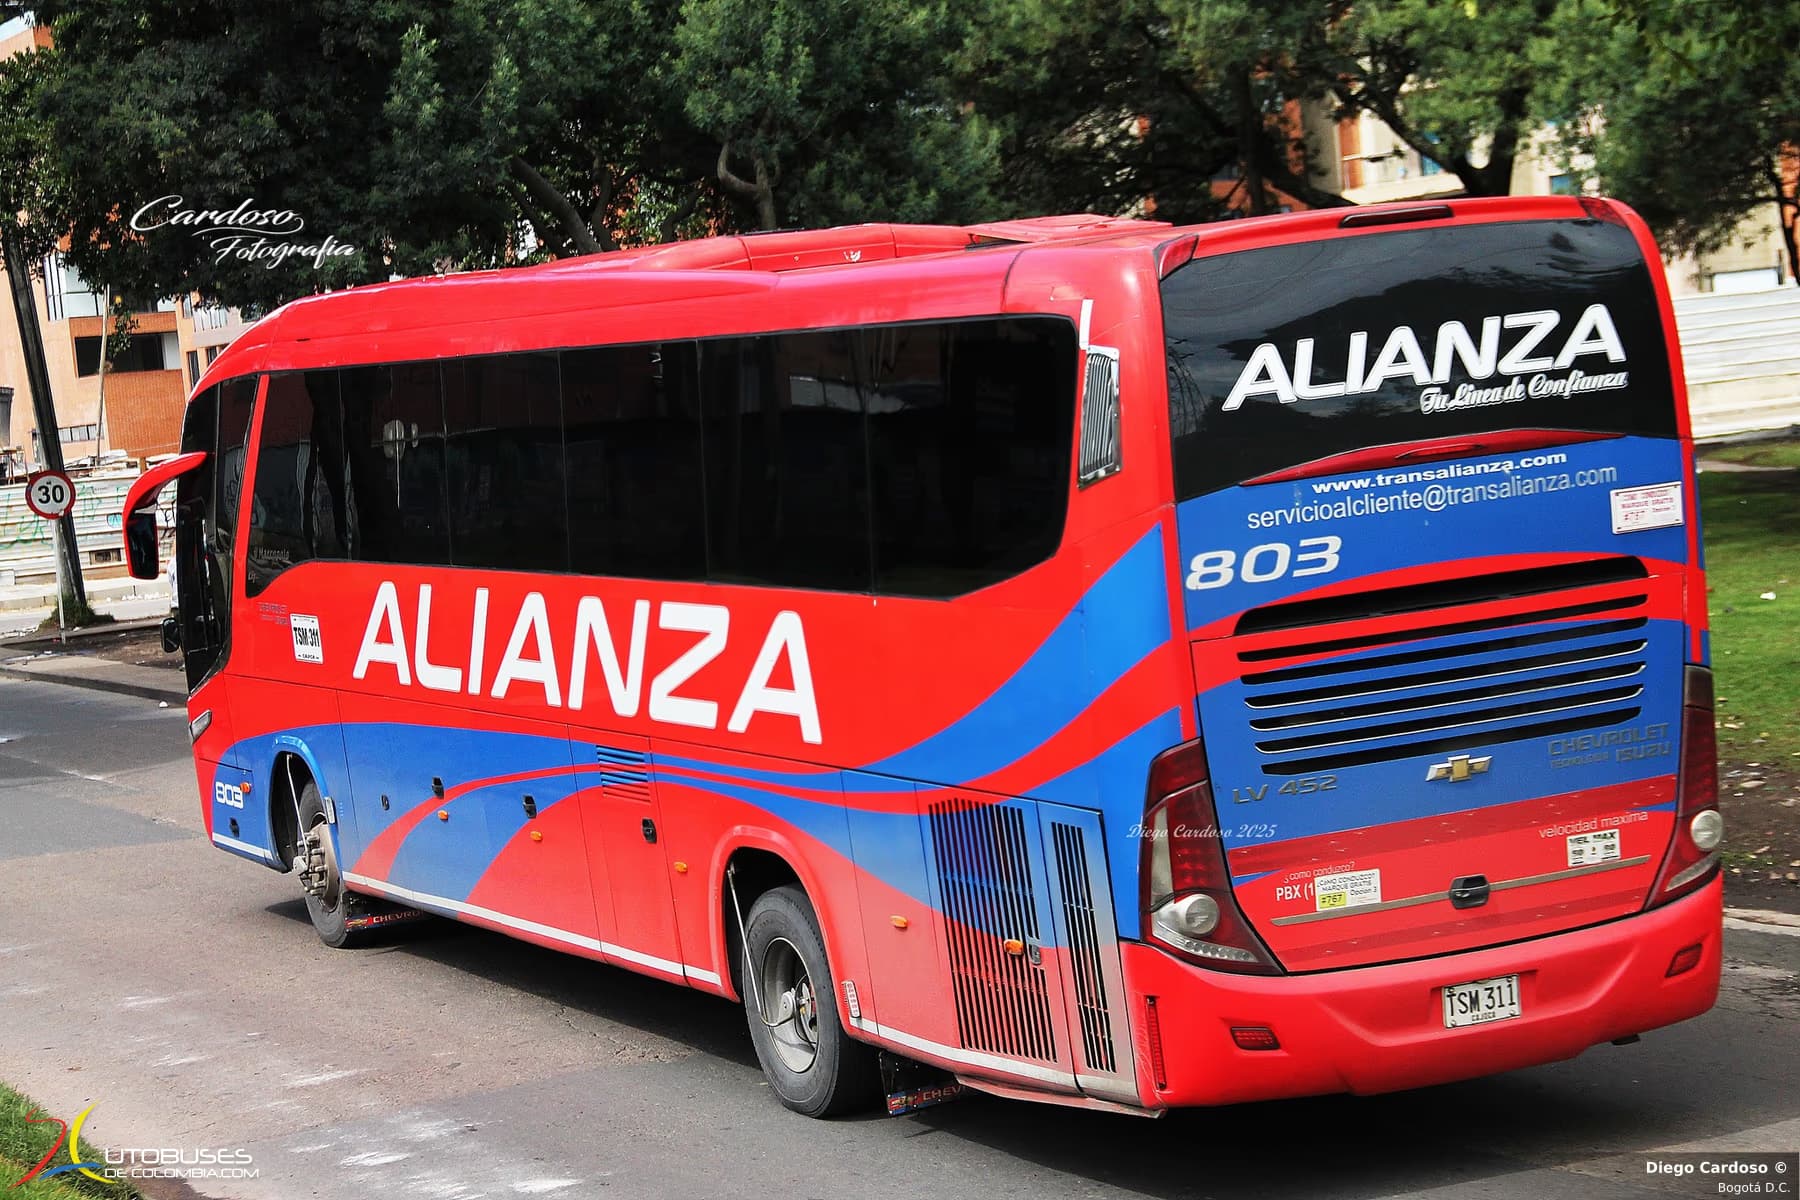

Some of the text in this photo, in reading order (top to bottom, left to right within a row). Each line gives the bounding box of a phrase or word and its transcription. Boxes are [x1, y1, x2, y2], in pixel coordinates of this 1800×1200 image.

[1222, 303, 1627, 412] ALIANZA
[1420, 387, 1449, 414] Tu
[1503, 376, 1525, 402] de
[1528, 368, 1629, 399] Confianza
[1312, 451, 1567, 495] www.transalianza.com
[38, 485, 65, 504] 30
[1247, 464, 1617, 530] servicioalcliente@transalianza.com
[1186, 535, 1343, 592] 803
[293, 627, 320, 647] TSM 311
[352, 580, 823, 745] ALIANZA
[1548, 722, 1670, 756] CHEVROLET
[1616, 741, 1672, 762] ISUZU
[215, 781, 243, 809] 803
[1232, 775, 1338, 804] LV 452
[1539, 811, 1649, 838] velocidad maxima
[1276, 884, 1302, 902] PBX
[1446, 983, 1516, 1016] TSM 311
